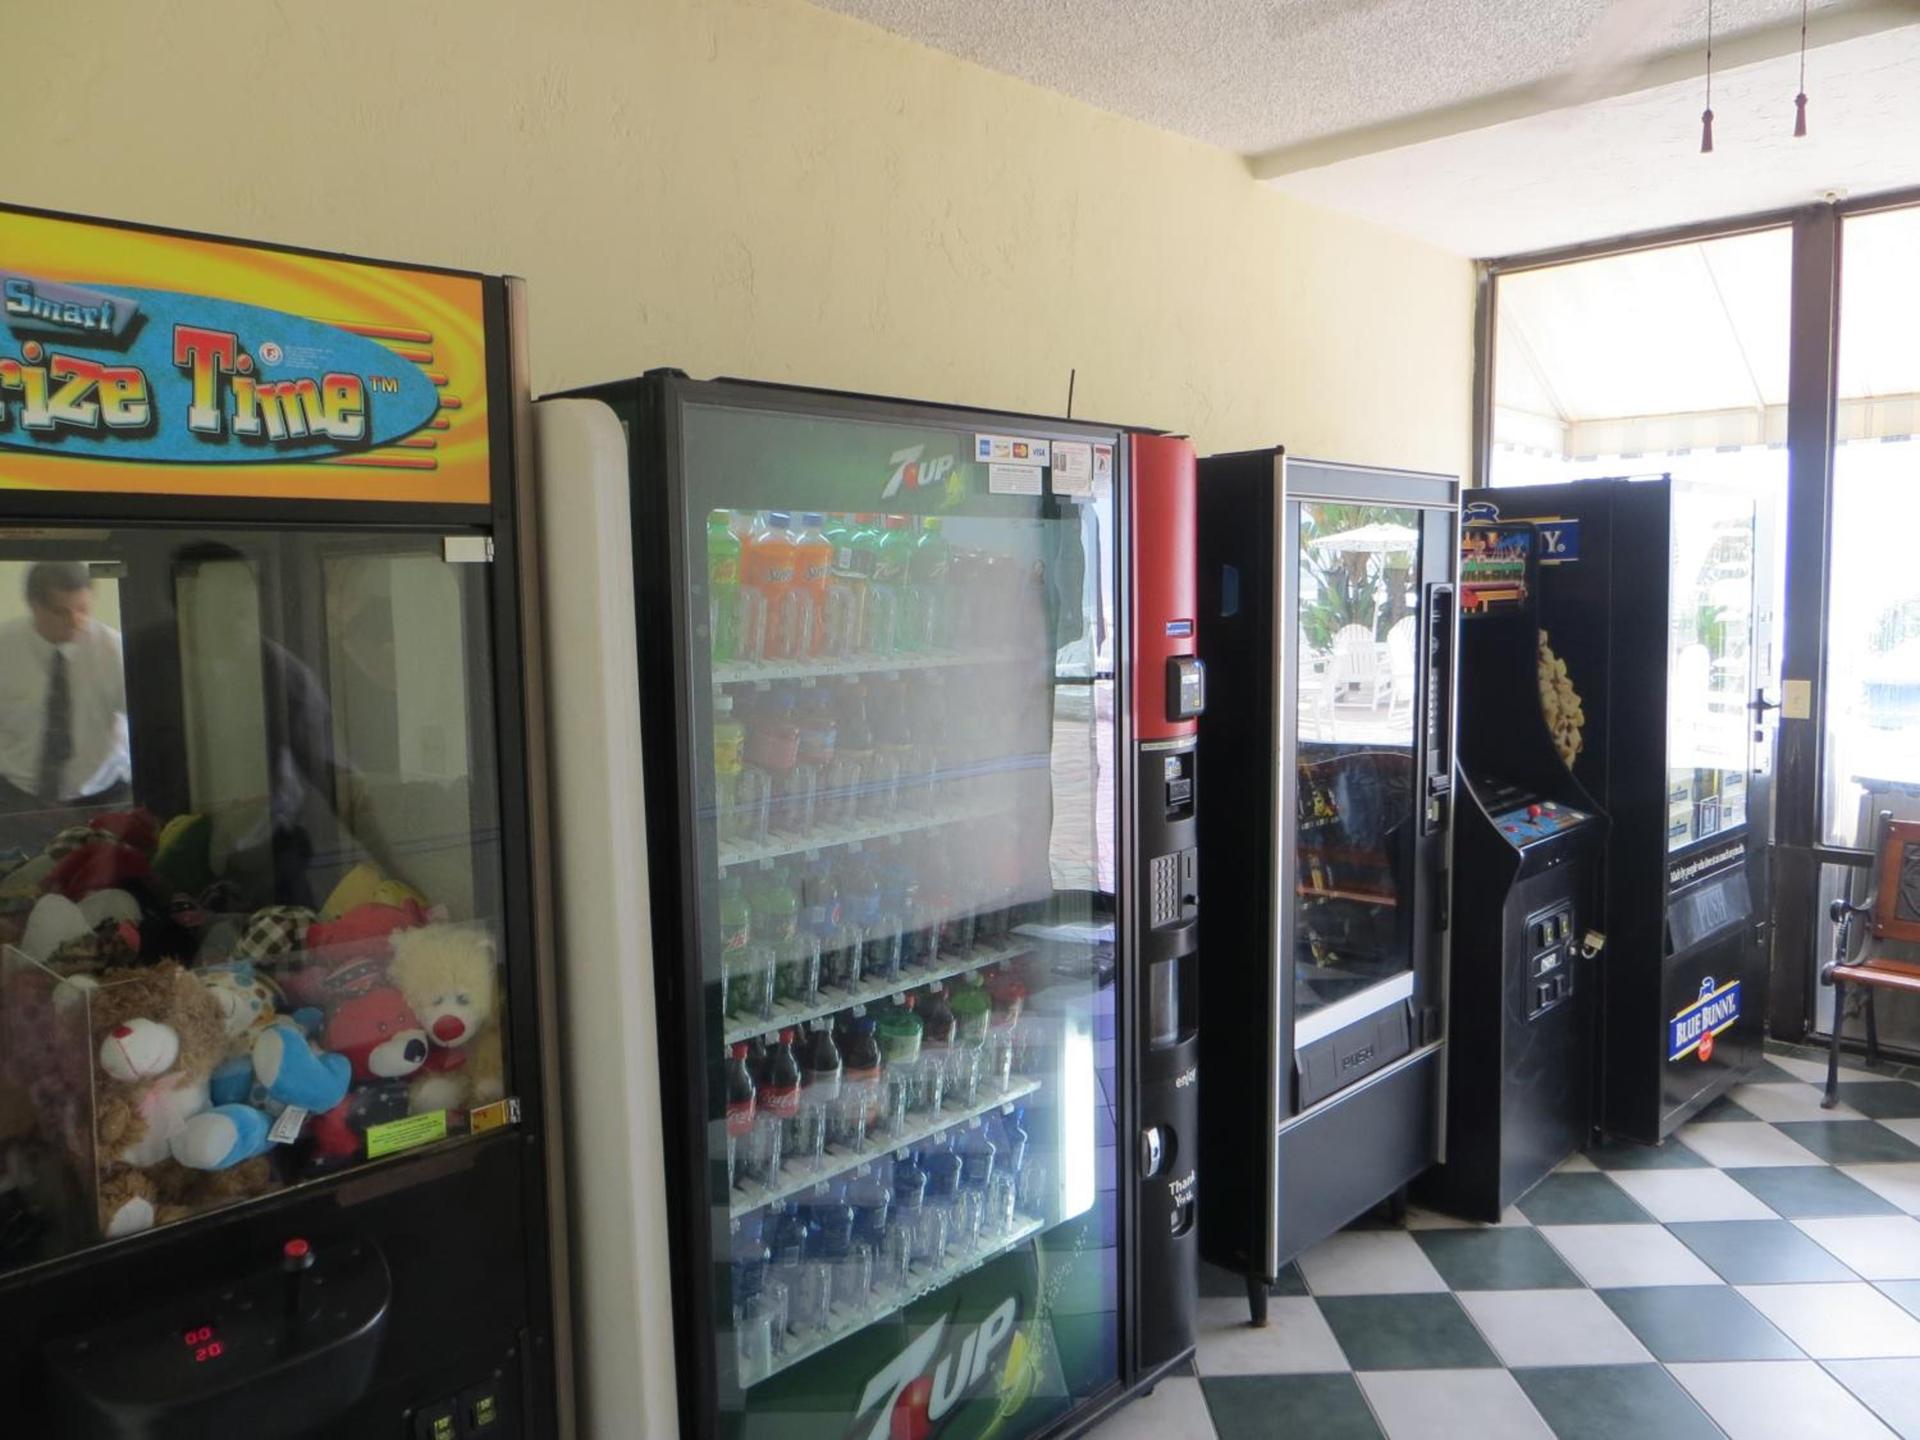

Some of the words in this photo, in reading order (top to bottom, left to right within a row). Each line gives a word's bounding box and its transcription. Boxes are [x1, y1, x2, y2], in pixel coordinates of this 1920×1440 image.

[5, 279, 113, 330] Smart
[173, 324, 365, 441] Time
[1676, 1013, 1702, 1048] BLUE
